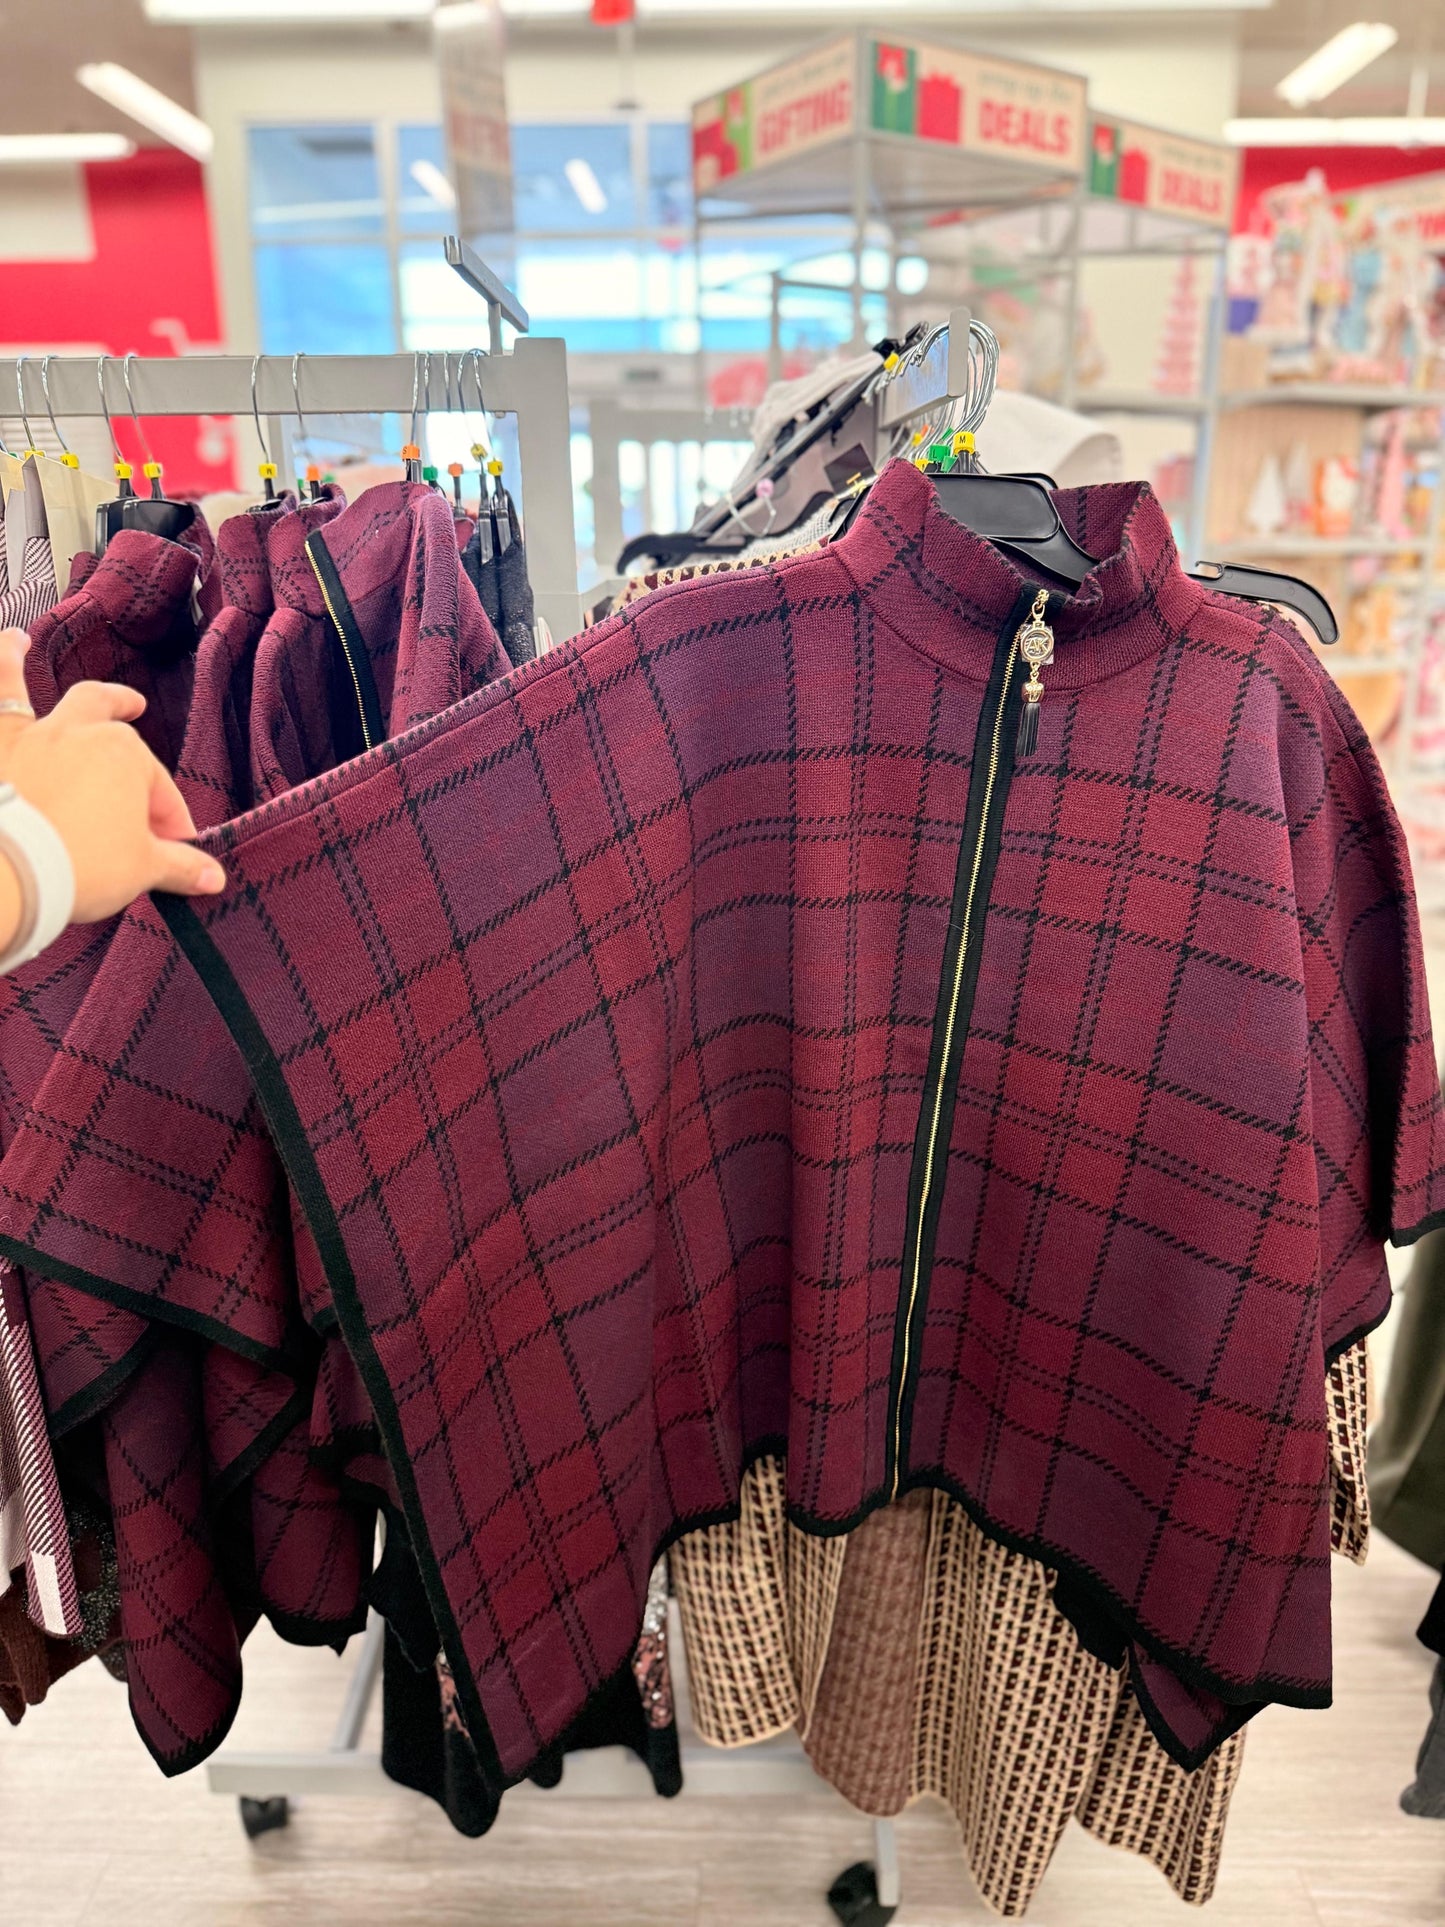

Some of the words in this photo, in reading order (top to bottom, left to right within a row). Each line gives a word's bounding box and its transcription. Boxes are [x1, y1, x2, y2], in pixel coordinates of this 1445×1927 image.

[757, 81, 851, 155] GIFTING
[979, 98, 1071, 155] DEALS
[1161, 169, 1223, 214] DEALS
[959, 435, 966, 444] M
